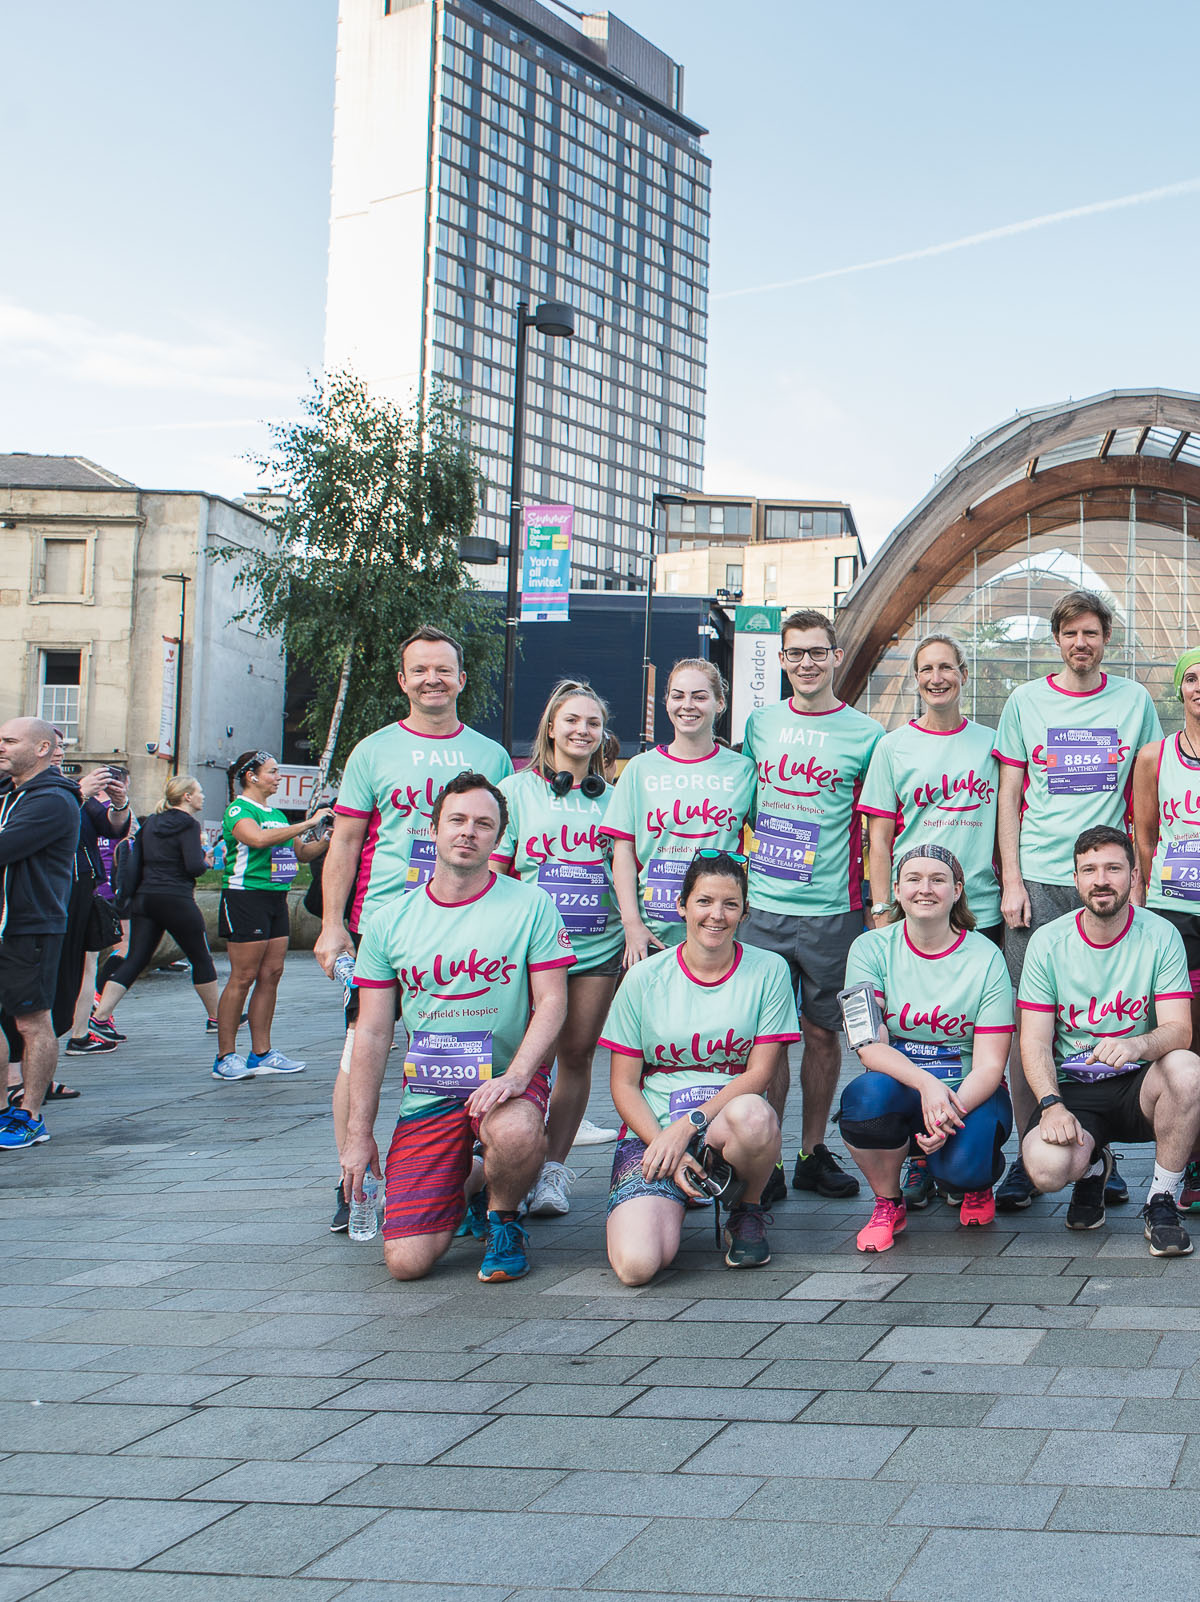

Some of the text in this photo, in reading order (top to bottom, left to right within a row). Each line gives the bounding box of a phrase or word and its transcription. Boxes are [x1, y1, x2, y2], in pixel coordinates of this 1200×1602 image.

[527, 512, 571, 527] Summer
[530, 556, 559, 567] You're
[529, 577, 563, 588] invited.
[750, 640, 765, 690] Garden
[778, 727, 830, 748] MATT
[411, 750, 472, 767] PAUL
[1064, 754, 1101, 766] 8856
[779, 754, 843, 792] Luke's
[644, 774, 735, 792] GEORGE
[914, 770, 994, 814] St Luke's
[391, 785, 422, 817] St
[550, 796, 602, 815] ELLA
[762, 800, 825, 815] Sheffield's Hospice
[647, 798, 737, 839] St Luke's
[1163, 797, 1181, 827] St
[924, 819, 983, 828] Sheffield's Hospice
[526, 833, 557, 864] St
[657, 846, 692, 854] Sheffield's
[762, 843, 803, 861] 11719
[777, 859, 793, 868] TEAM
[794, 862, 807, 870] PPP
[551, 893, 599, 906] 12765
[656, 888, 681, 901] 117
[433, 948, 517, 985] Luke's
[418, 1006, 499, 1021] Sheffield's Hospice
[899, 1003, 974, 1038] Luke's
[442, 1041, 482, 1049] MARATHON
[420, 1064, 476, 1079] 12230
